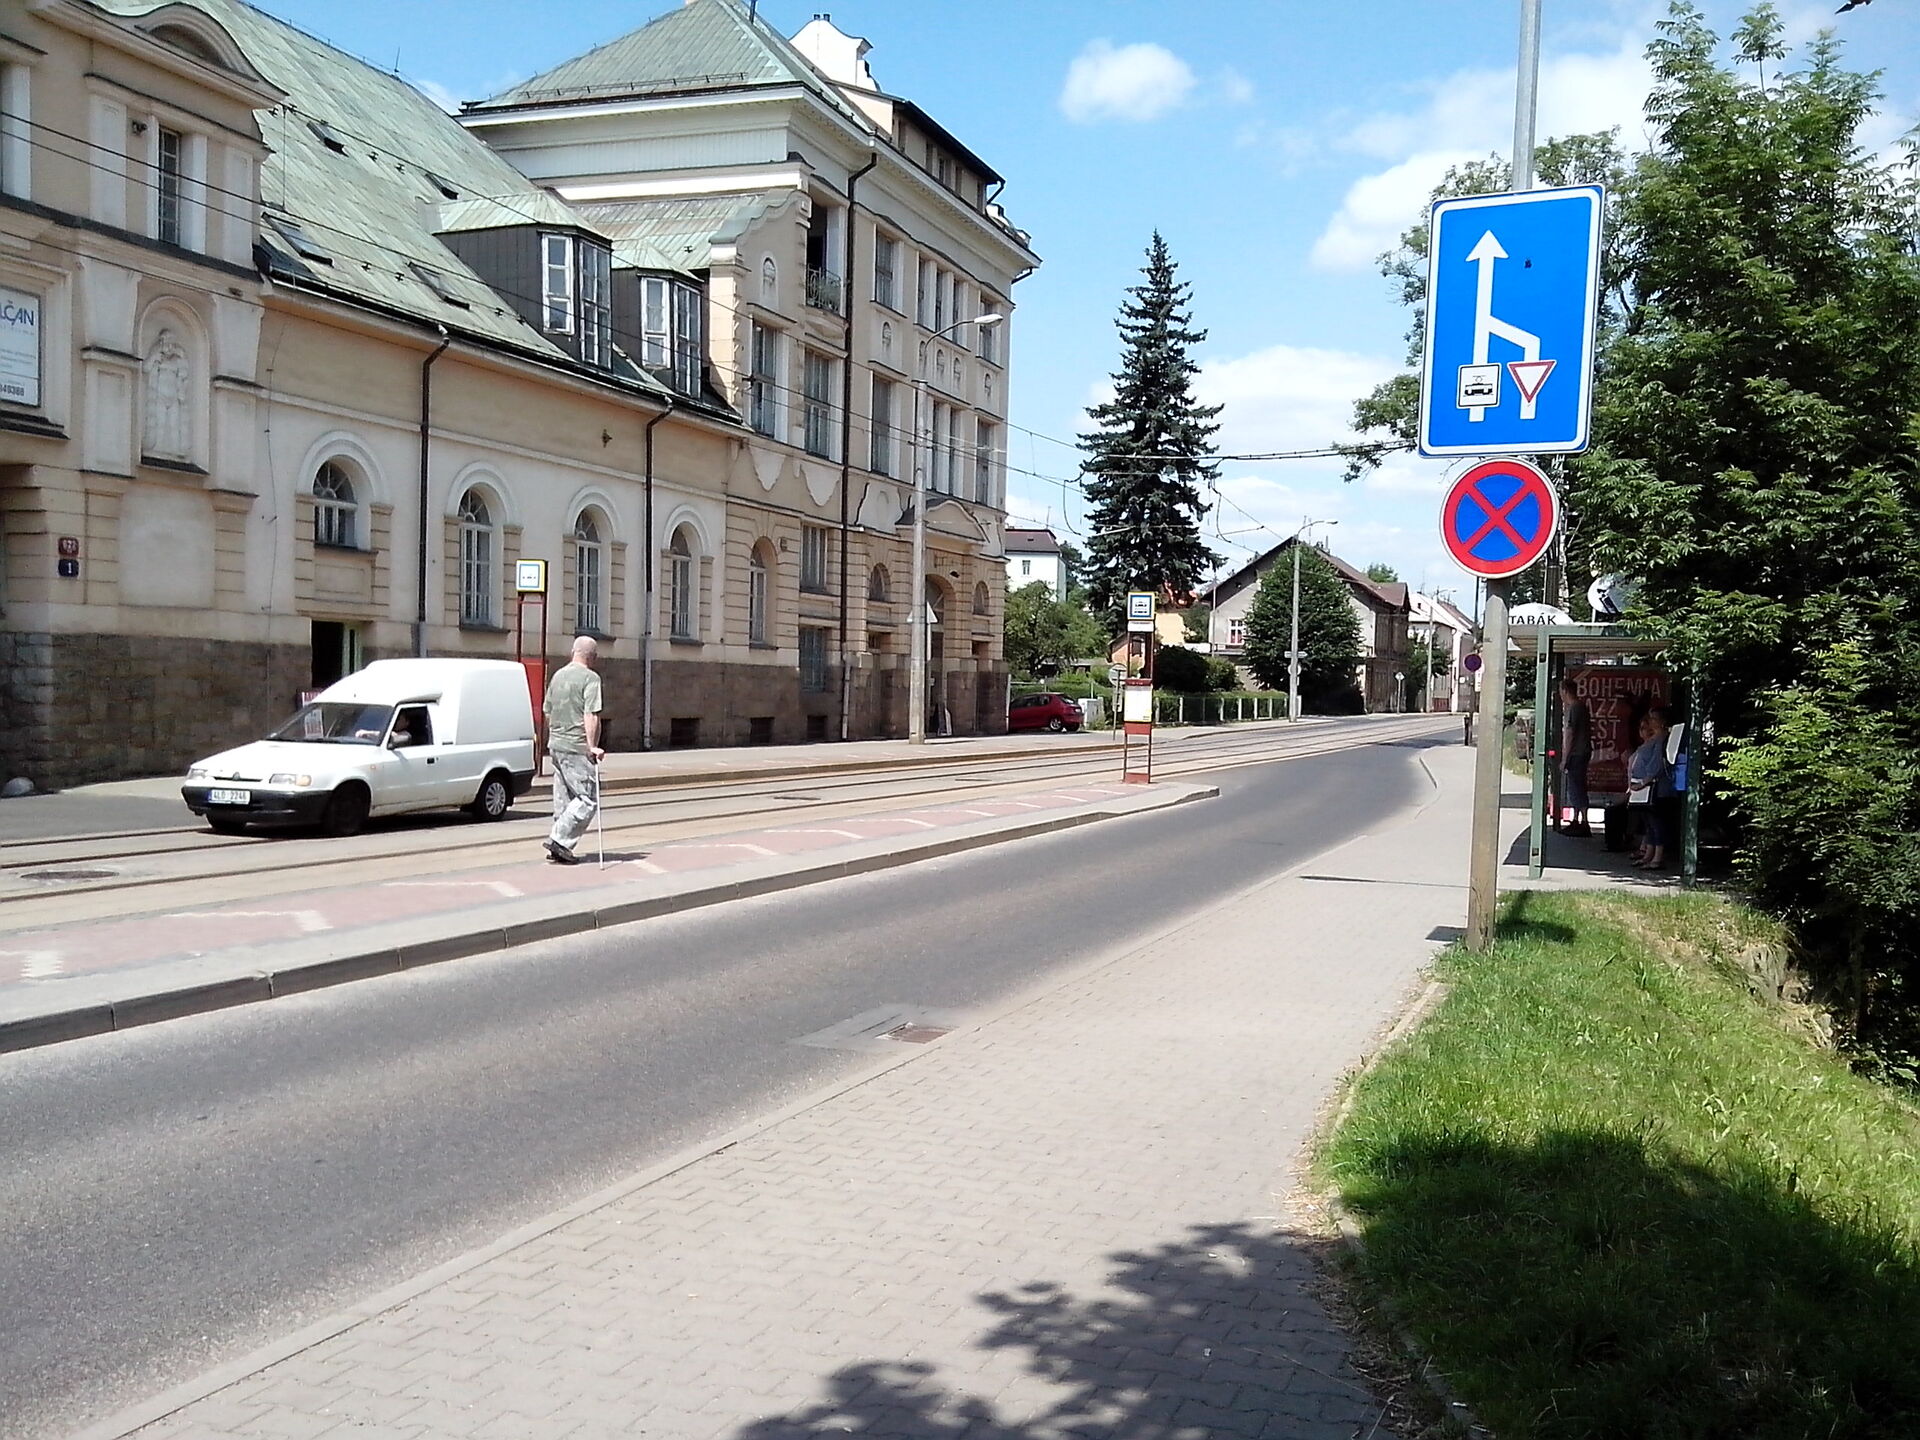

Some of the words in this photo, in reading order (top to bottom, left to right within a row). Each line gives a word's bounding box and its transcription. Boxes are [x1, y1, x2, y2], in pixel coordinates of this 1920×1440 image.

[1508, 612, 1557, 625] TABÁK
[1576, 676, 1661, 698] BOHEMIA
[1586, 697, 1618, 719] AZZ
